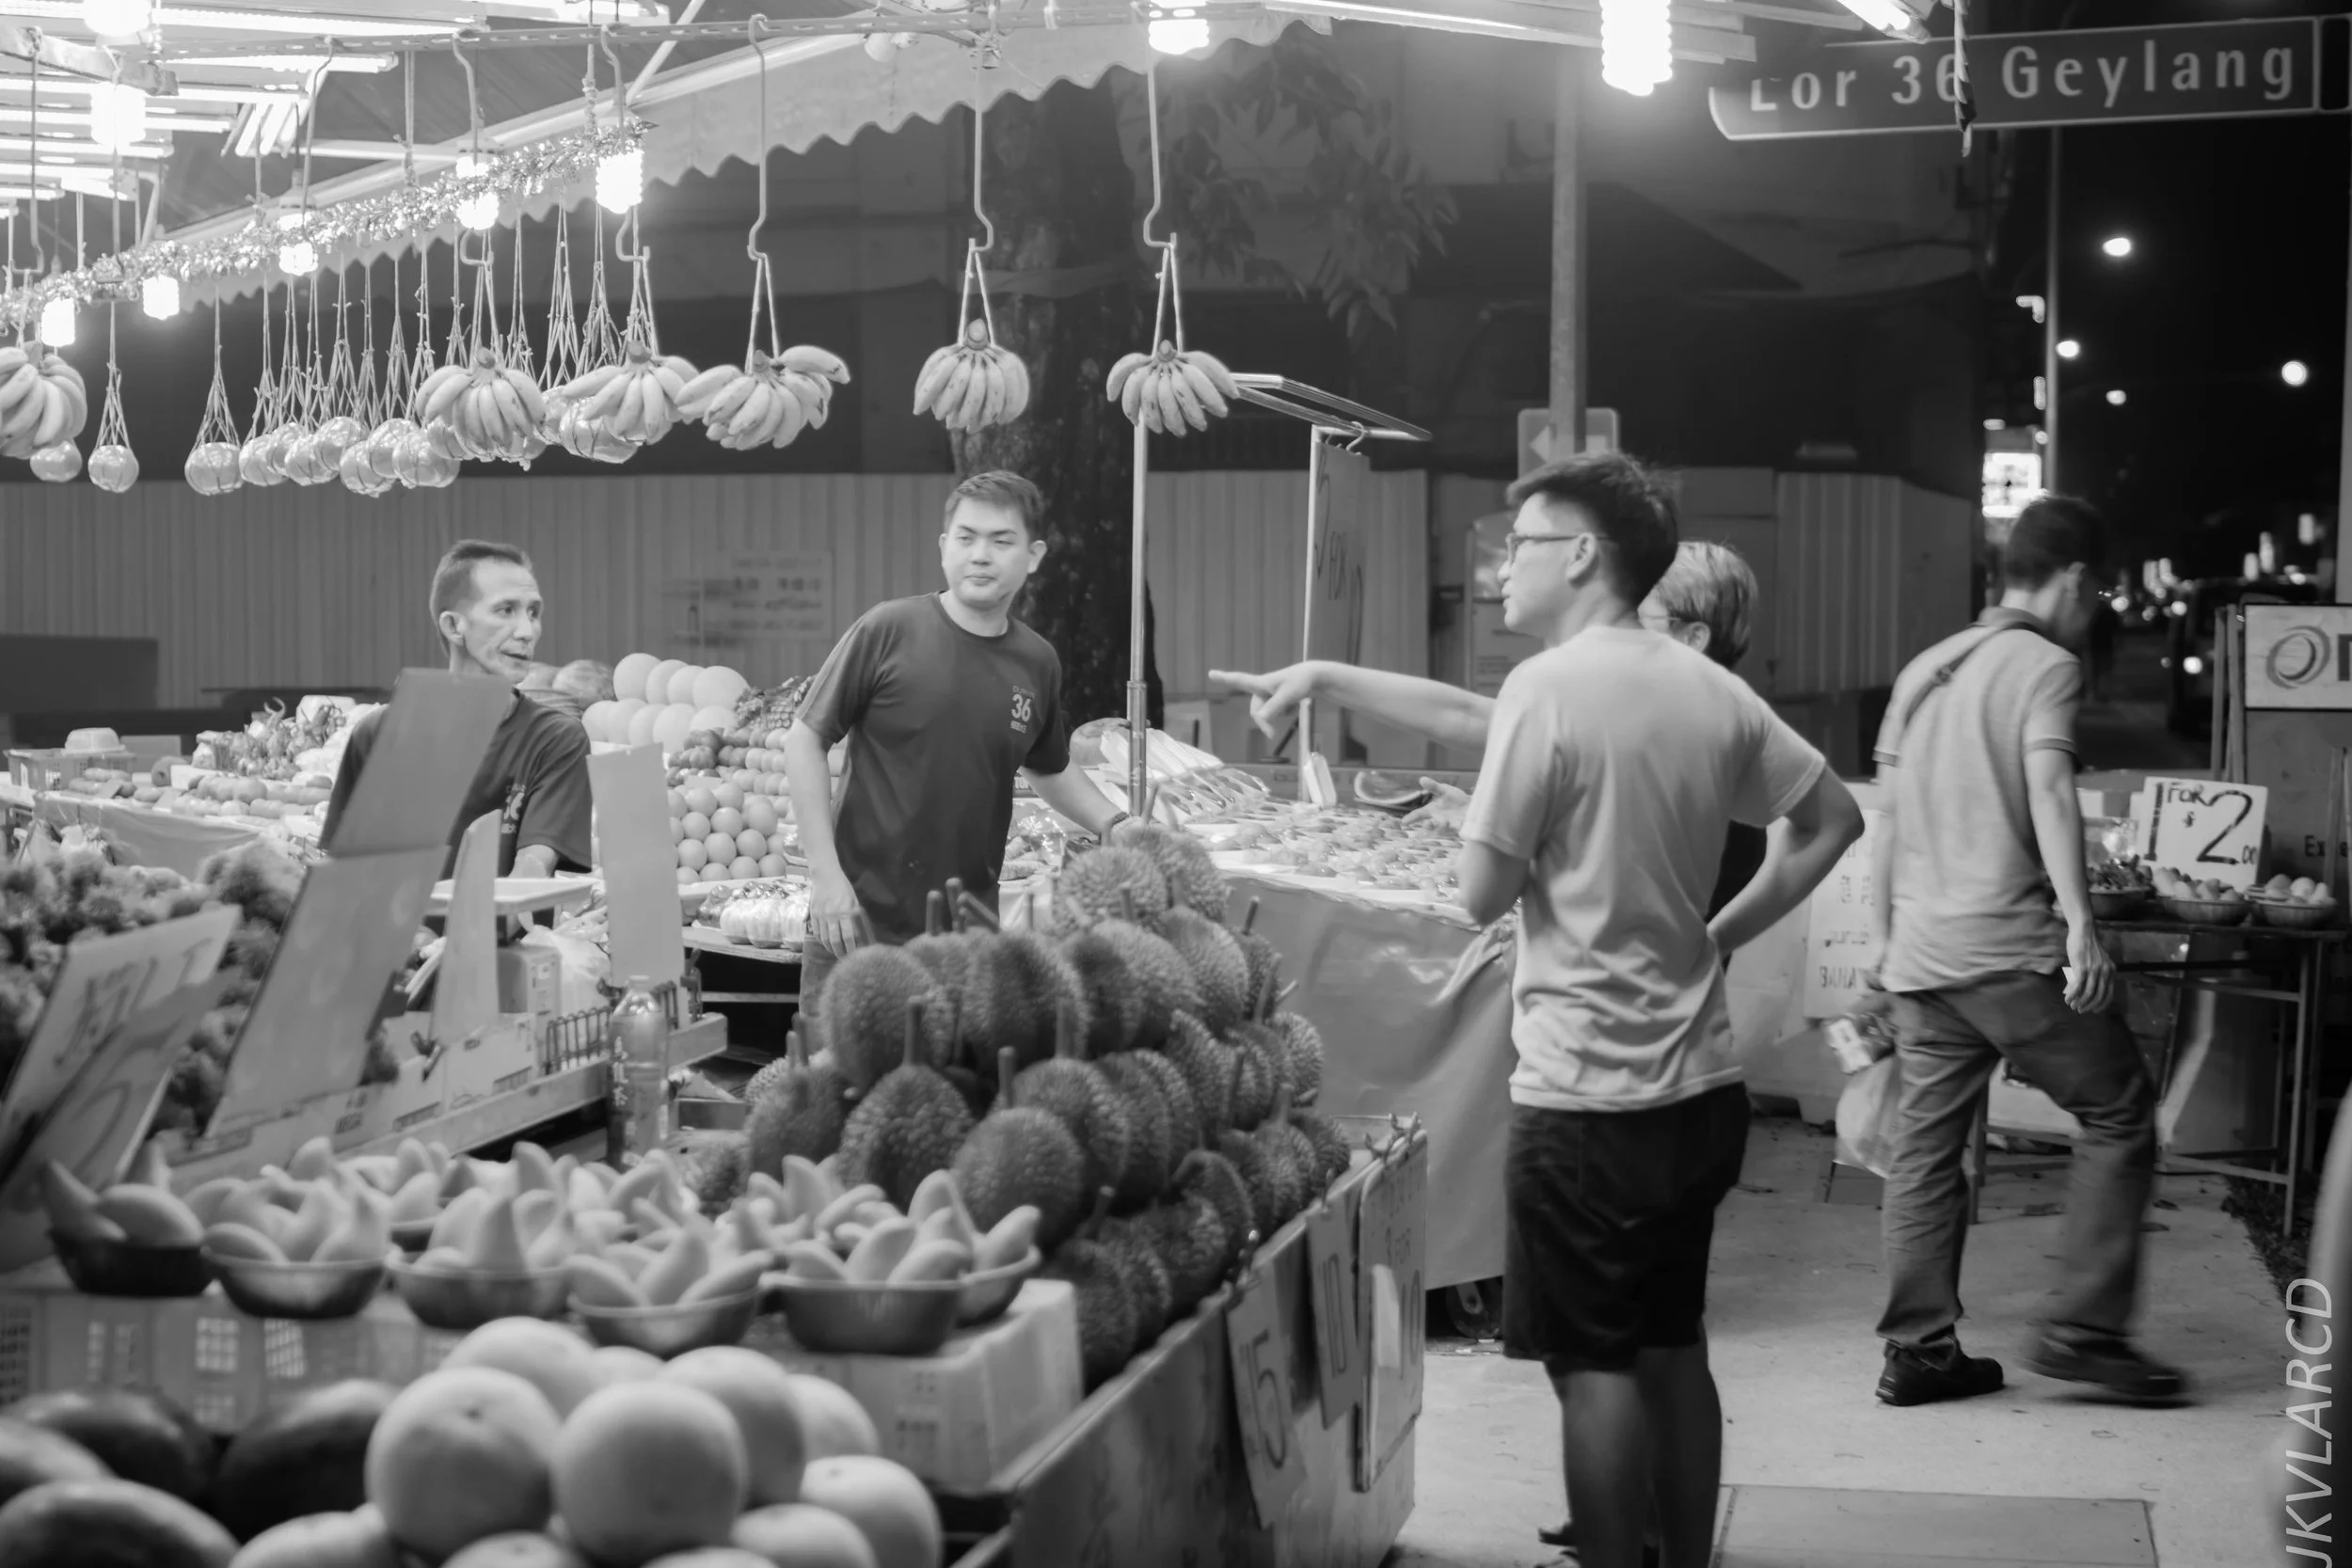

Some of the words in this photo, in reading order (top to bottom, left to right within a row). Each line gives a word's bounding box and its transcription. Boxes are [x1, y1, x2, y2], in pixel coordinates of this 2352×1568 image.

[1750, 68, 1857, 112] Lor
[1891, 55, 1961, 105] 36
[2001, 40, 2294, 108] Geylang
[1010, 693, 1032, 722] 36
[2168, 782, 2208, 806] FOR
